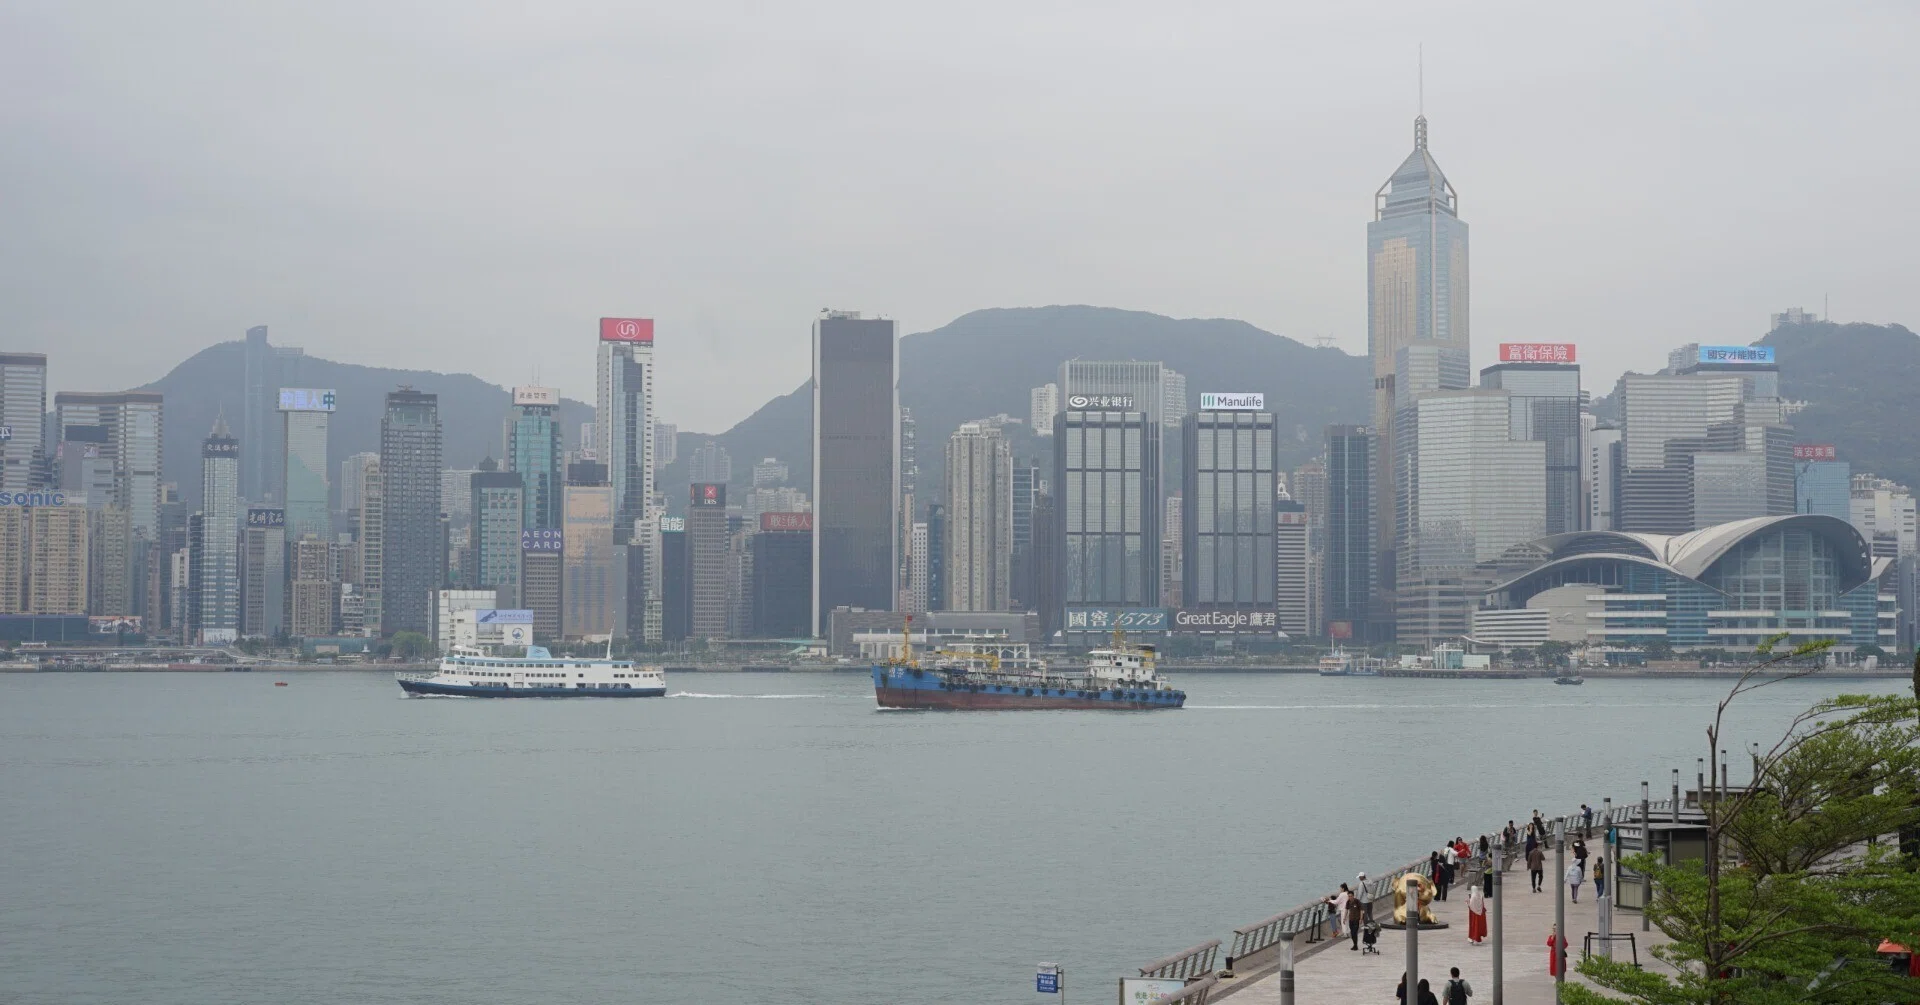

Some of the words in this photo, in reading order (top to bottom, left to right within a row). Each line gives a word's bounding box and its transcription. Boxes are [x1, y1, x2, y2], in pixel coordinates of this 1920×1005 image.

[1508, 345, 1568, 360] 富衛保險
[1088, 395, 1133, 407] 兴业银行
[1217, 395, 1262, 407] Manulife
[0, 488, 65, 506] sonic
[522, 530, 562, 538] AEON
[522, 541, 562, 549] CARD
[1111, 612, 1164, 626] 1573
[1176, 611, 1211, 625] Great
[1213, 611, 1247, 629] Eagle
